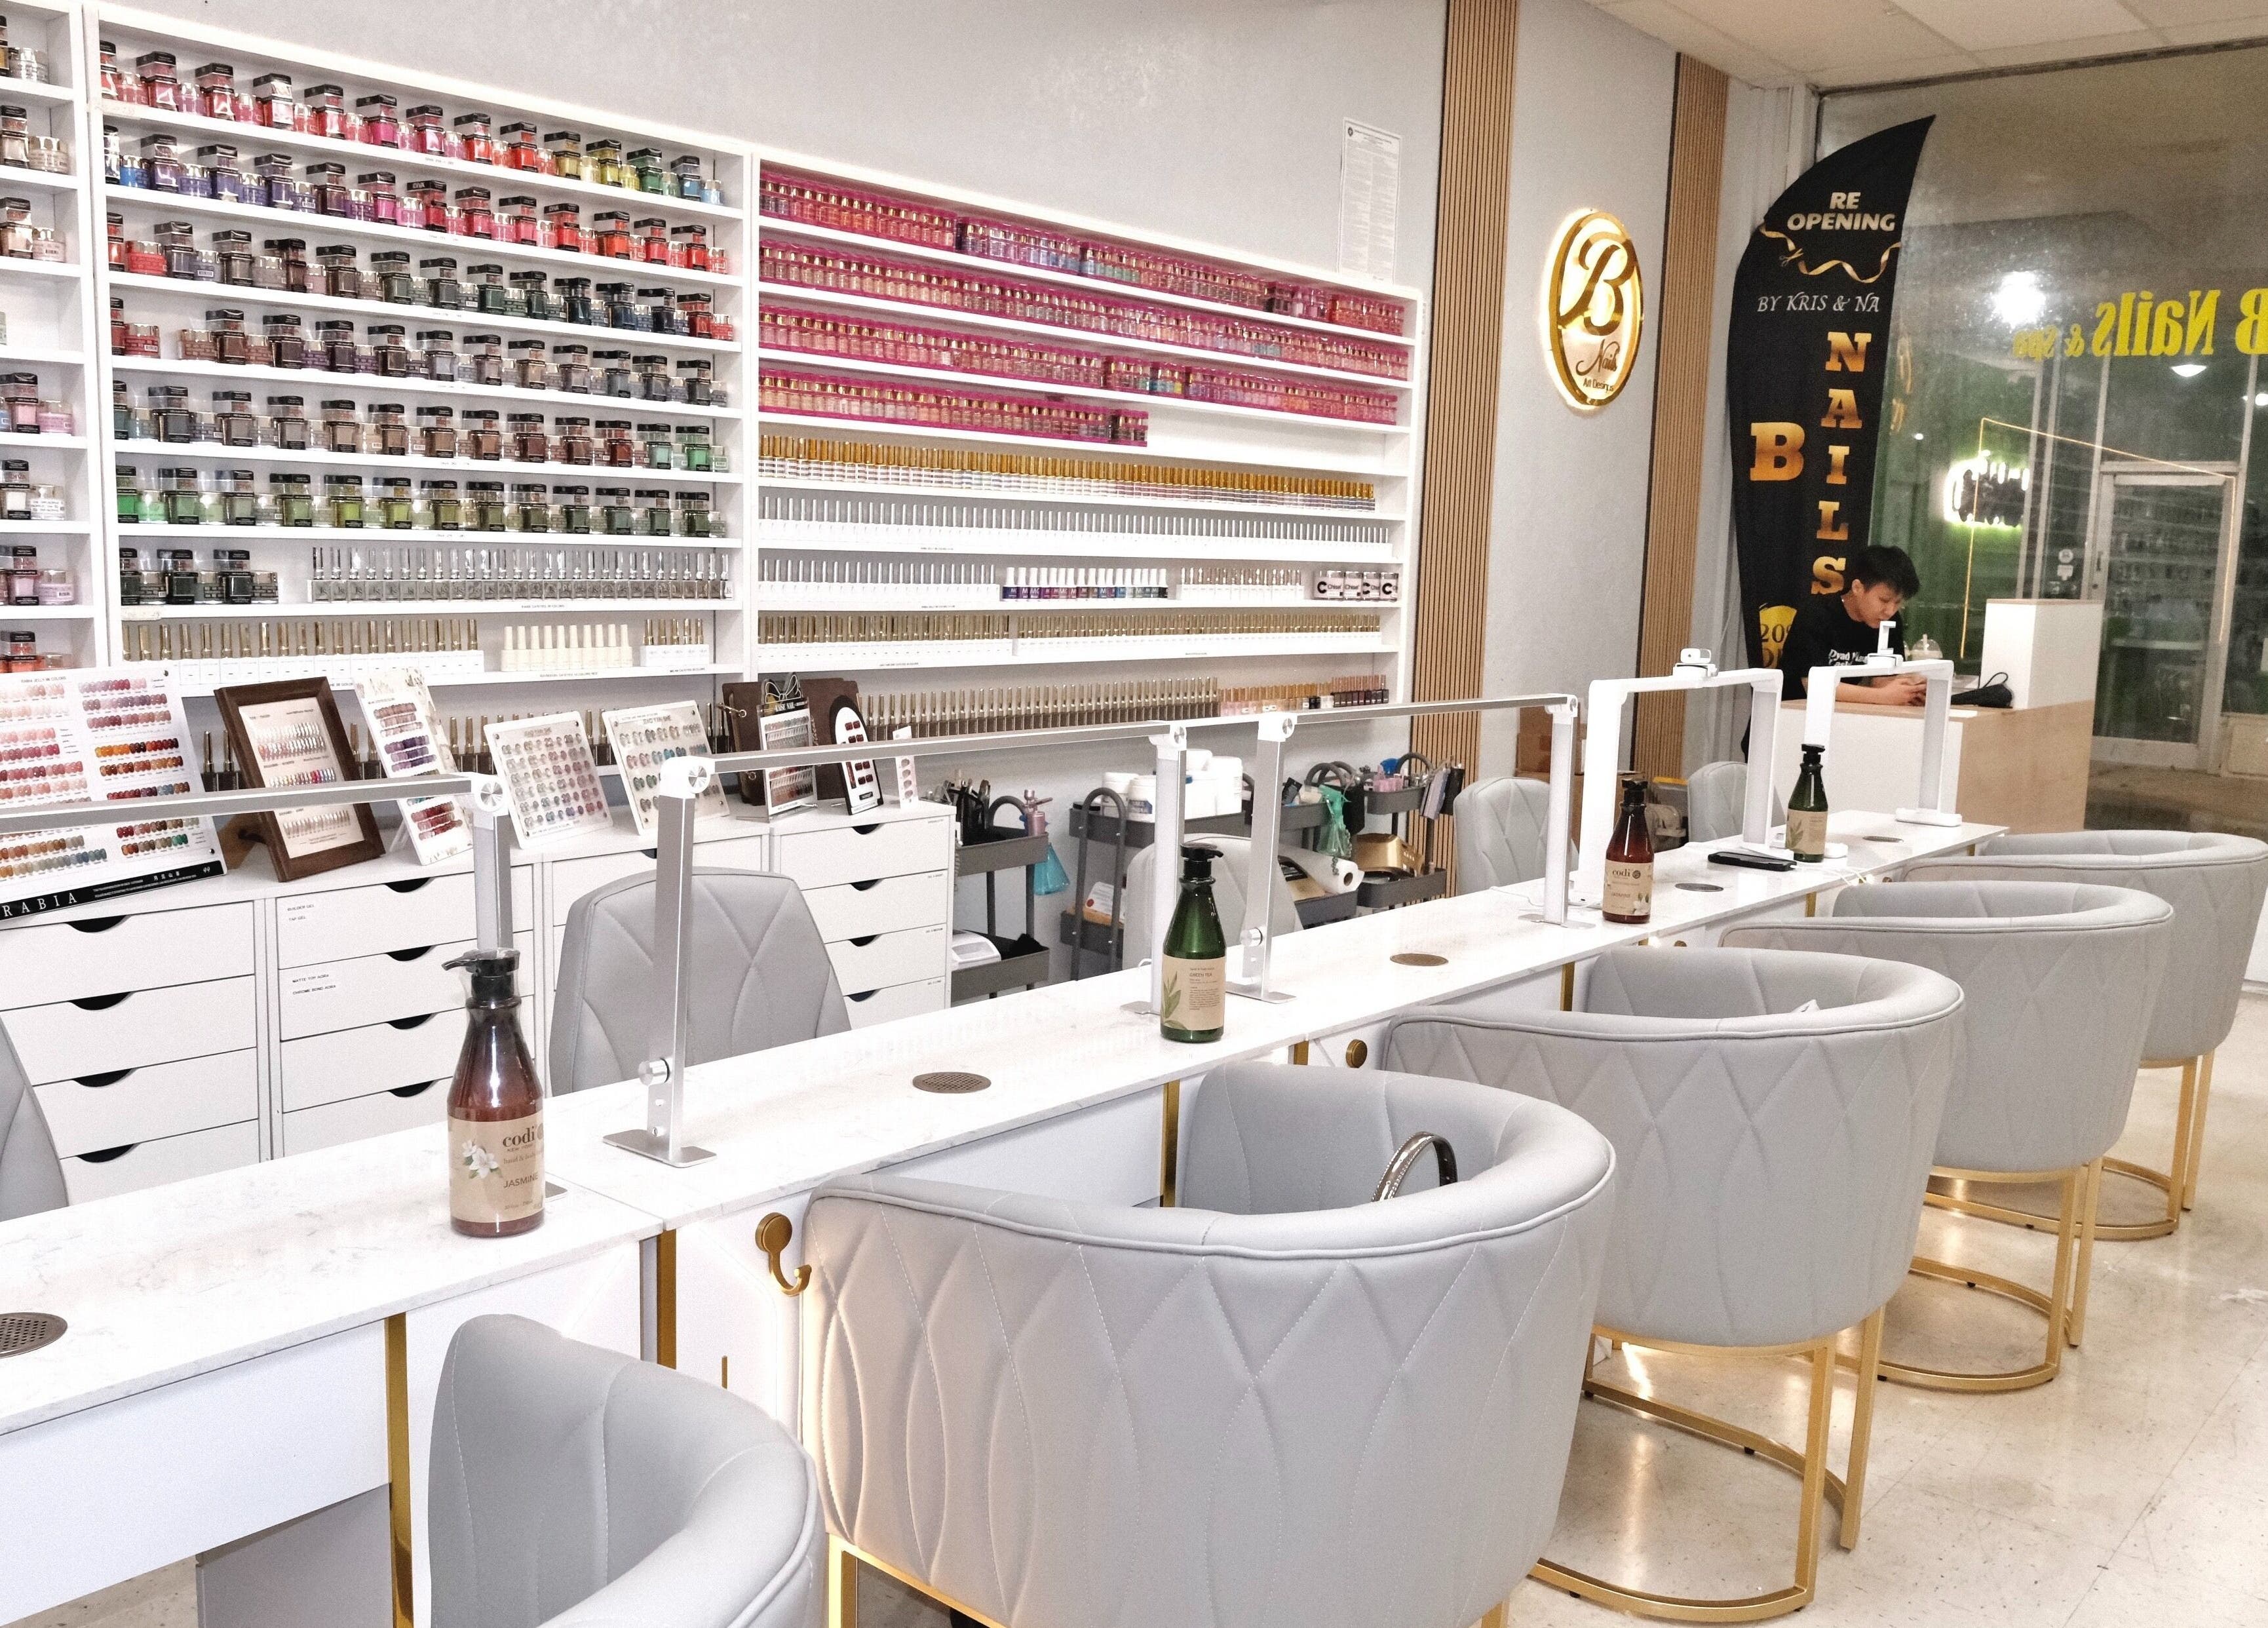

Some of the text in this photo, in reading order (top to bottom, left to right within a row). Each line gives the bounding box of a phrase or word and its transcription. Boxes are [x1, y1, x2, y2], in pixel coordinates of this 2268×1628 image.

[1830, 192, 1861, 209] RE
[1787, 213, 1895, 231] OPENING
[1757, 292, 1879, 313] BY KRIS & NA
[1750, 422, 1805, 481] B
[1811, 332, 1872, 594] NAILS
[1760, 624, 1792, 643] 20
[1612, 868, 1630, 877] codi
[503, 1126, 535, 1148] codi
[503, 1173, 539, 1189] JASMINE
